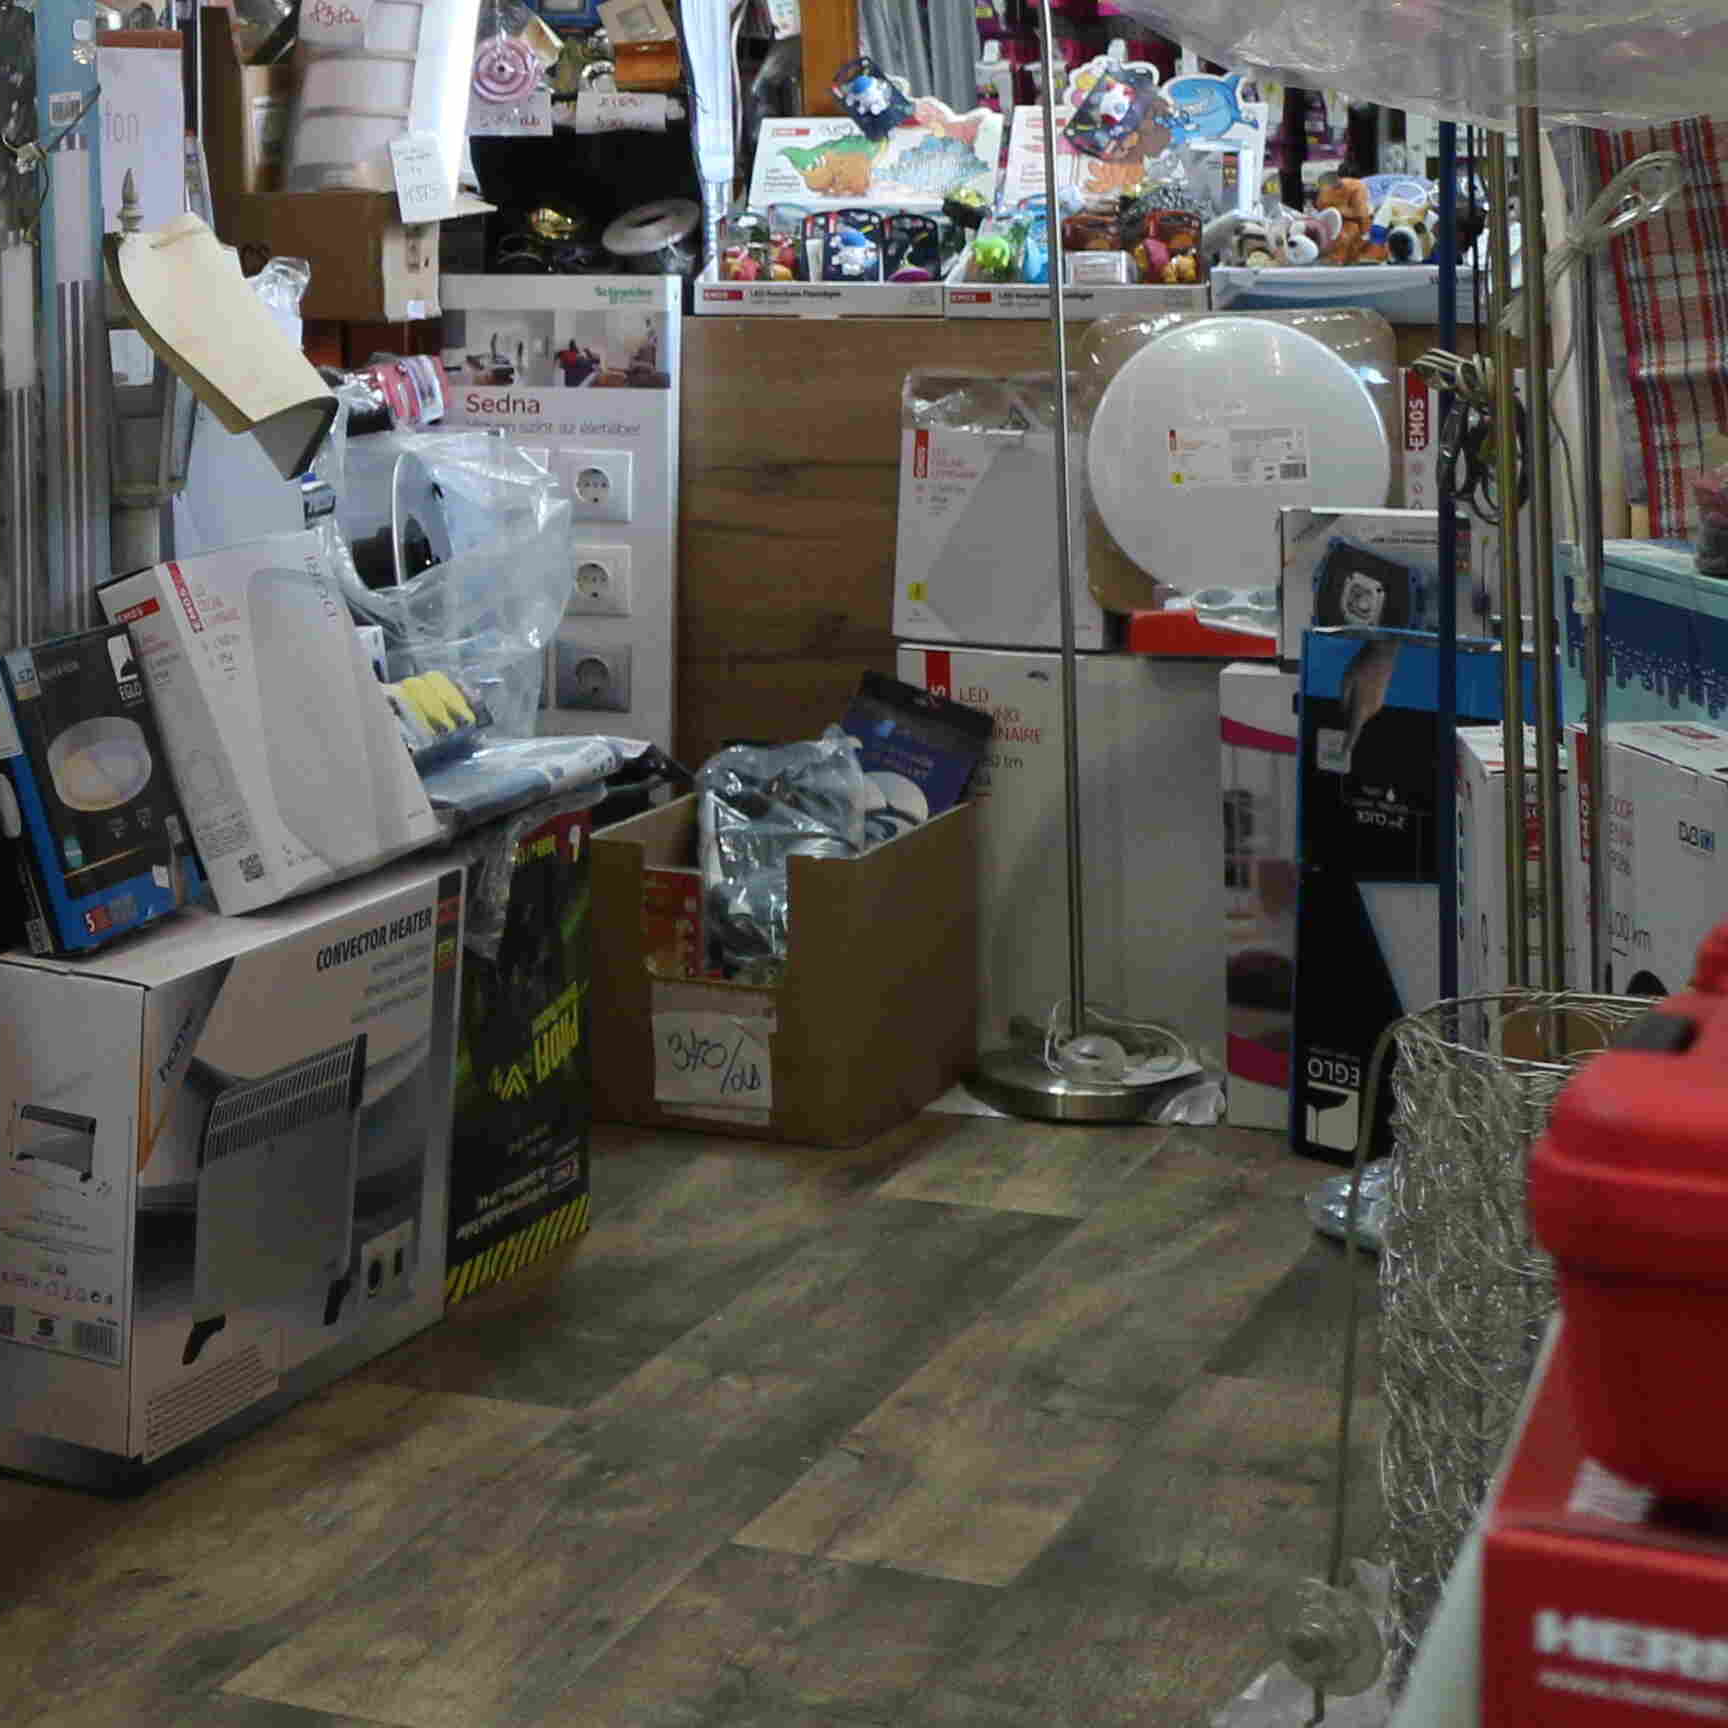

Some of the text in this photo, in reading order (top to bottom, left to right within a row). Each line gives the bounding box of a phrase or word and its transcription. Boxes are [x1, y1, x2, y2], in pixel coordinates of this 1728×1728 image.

[464, 393, 541, 417] Sedna
[1408, 398, 1425, 452] EMOS
[958, 687, 992, 704] LED
[316, 907, 433, 974] CONVECTOR HEATER
[1307, 1057, 1361, 1087] EGLO
